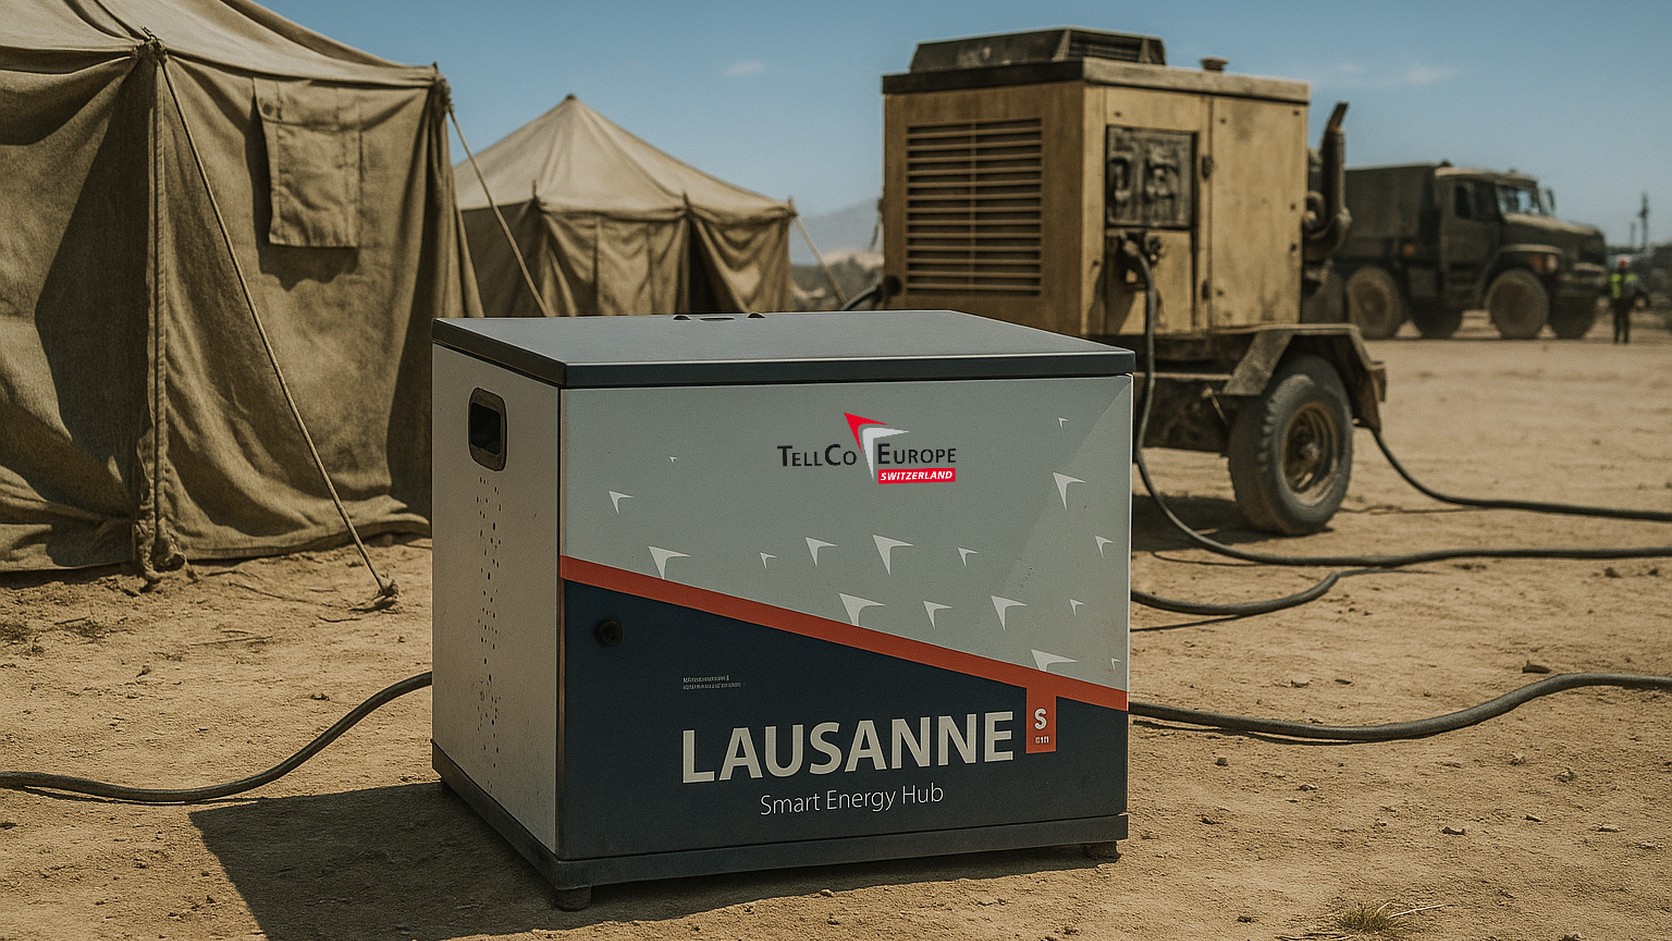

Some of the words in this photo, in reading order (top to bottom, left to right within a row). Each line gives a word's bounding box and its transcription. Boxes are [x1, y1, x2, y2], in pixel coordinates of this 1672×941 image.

[880, 470, 953, 481] SWITZERLAND
[1034, 708, 1047, 730] S
[682, 711, 1014, 784] LAUSANNE
[760, 792, 821, 816] Smart
[826, 787, 897, 812] Energy
[902, 783, 945, 804] Hub
